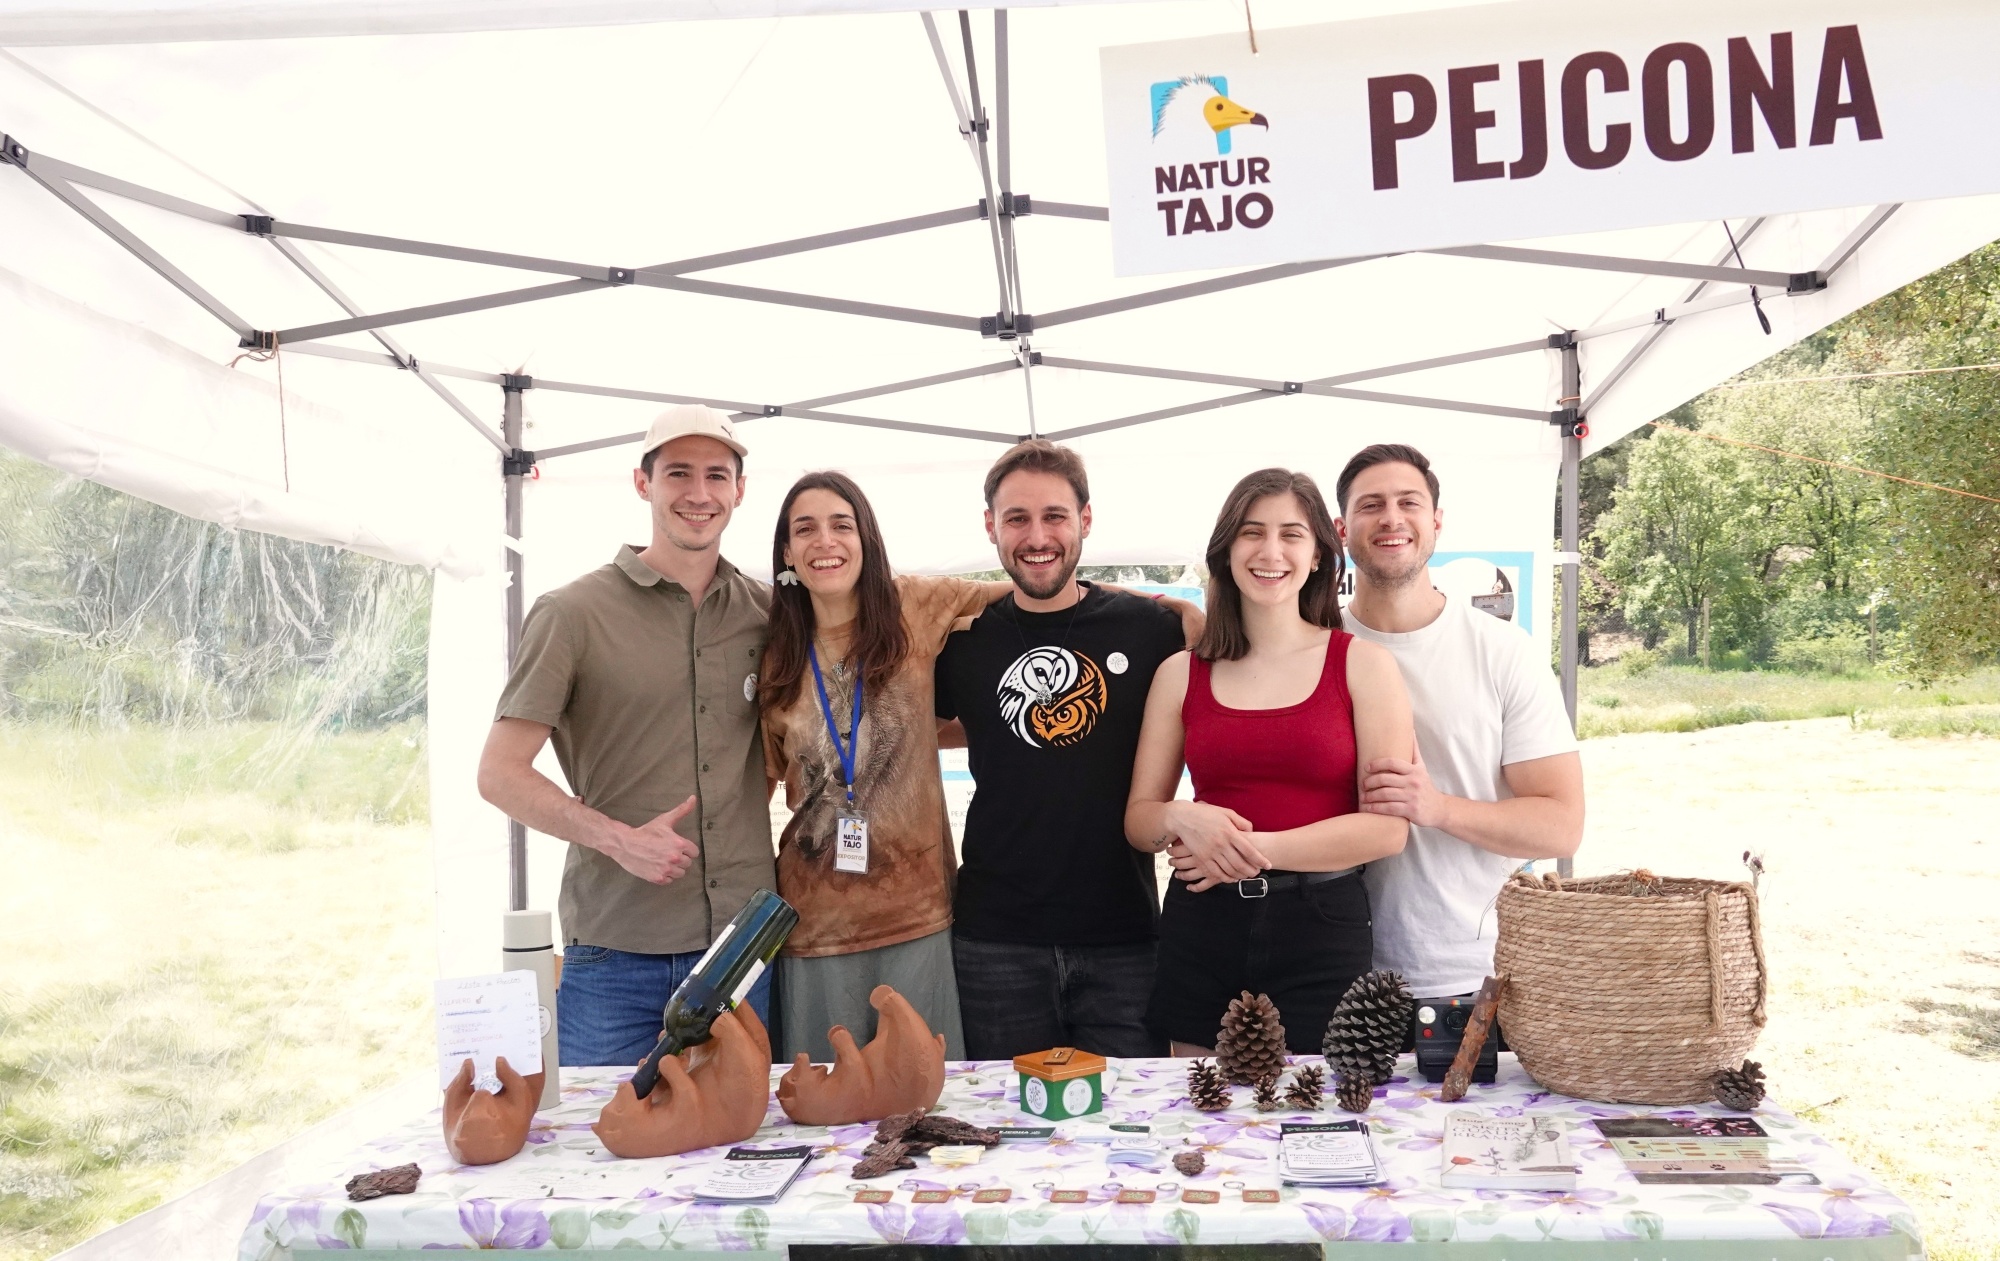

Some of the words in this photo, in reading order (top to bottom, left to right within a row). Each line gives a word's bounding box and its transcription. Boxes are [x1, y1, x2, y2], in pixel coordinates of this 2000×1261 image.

[1367, 24, 1883, 190] PEJCONA
[1155, 157, 1271, 194] NATUR
[1157, 192, 1274, 236] TAJO
[843, 840, 861, 848] TAJO
